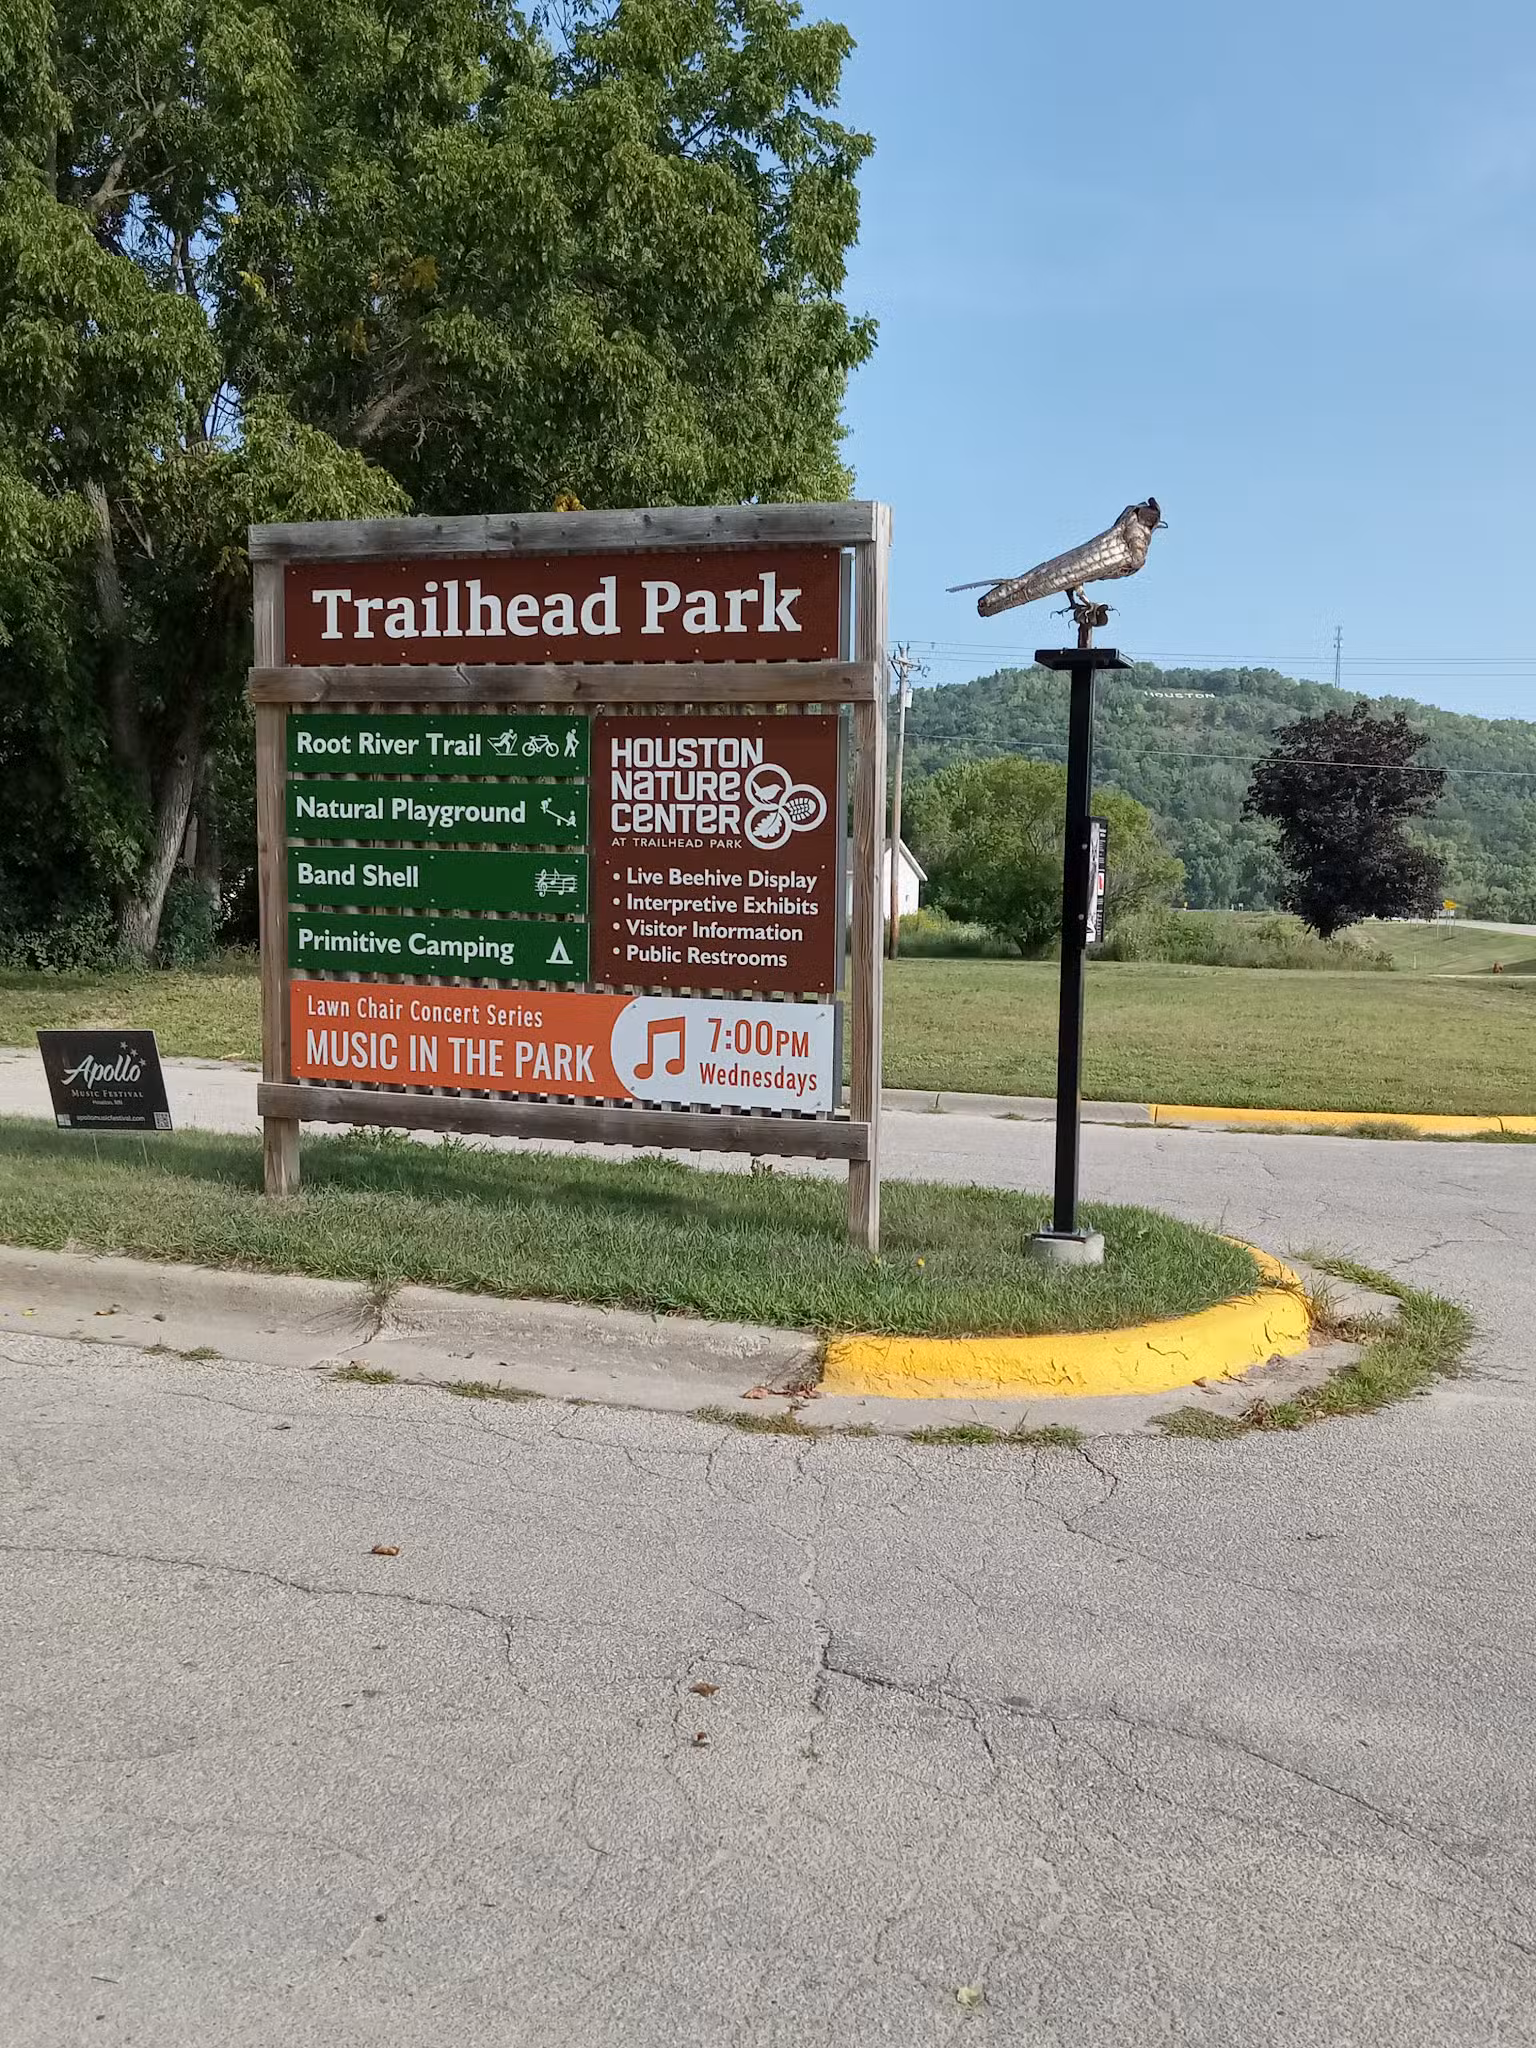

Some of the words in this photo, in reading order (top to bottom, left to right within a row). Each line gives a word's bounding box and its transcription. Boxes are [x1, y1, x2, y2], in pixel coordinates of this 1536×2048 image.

[312, 576, 621, 639] Trailhead
[640, 571, 802, 634] Park
[297, 732, 351, 754] Root
[359, 732, 419, 755] River
[425, 733, 481, 756] Trail
[611, 737, 763, 768] HOUSTON
[296, 796, 383, 820] Natural
[391, 797, 526, 828] Playground
[611, 837, 627, 847] AT
[632, 838, 703, 848] TRAILHEAD
[710, 839, 742, 849] PARK
[298, 863, 355, 886] Band
[363, 864, 419, 888] Shell
[626, 867, 664, 884] Live
[668, 868, 742, 887] Beehive
[748, 870, 817, 893] Display
[626, 893, 737, 916] Interpretive
[743, 896, 819, 915] Exhibits
[626, 919, 687, 937] Visitor
[692, 921, 803, 941] Information
[299, 928, 401, 954] Primitive
[408, 933, 515, 965] Camping
[626, 945, 682, 963] Public
[687, 947, 788, 967] Restrooms
[308, 995, 350, 1017] Lawn
[357, 997, 402, 1020] Chair
[410, 1001, 480, 1024] Concert
[487, 1004, 543, 1028] Series
[61, 1054, 141, 1089] Apollo
[306, 1029, 398, 1070] MUSIC
[409, 1035, 438, 1073] IN
[448, 1037, 504, 1077] THE
[515, 1041, 595, 1083] PARK
[700, 1062, 818, 1097] Wednesdays
